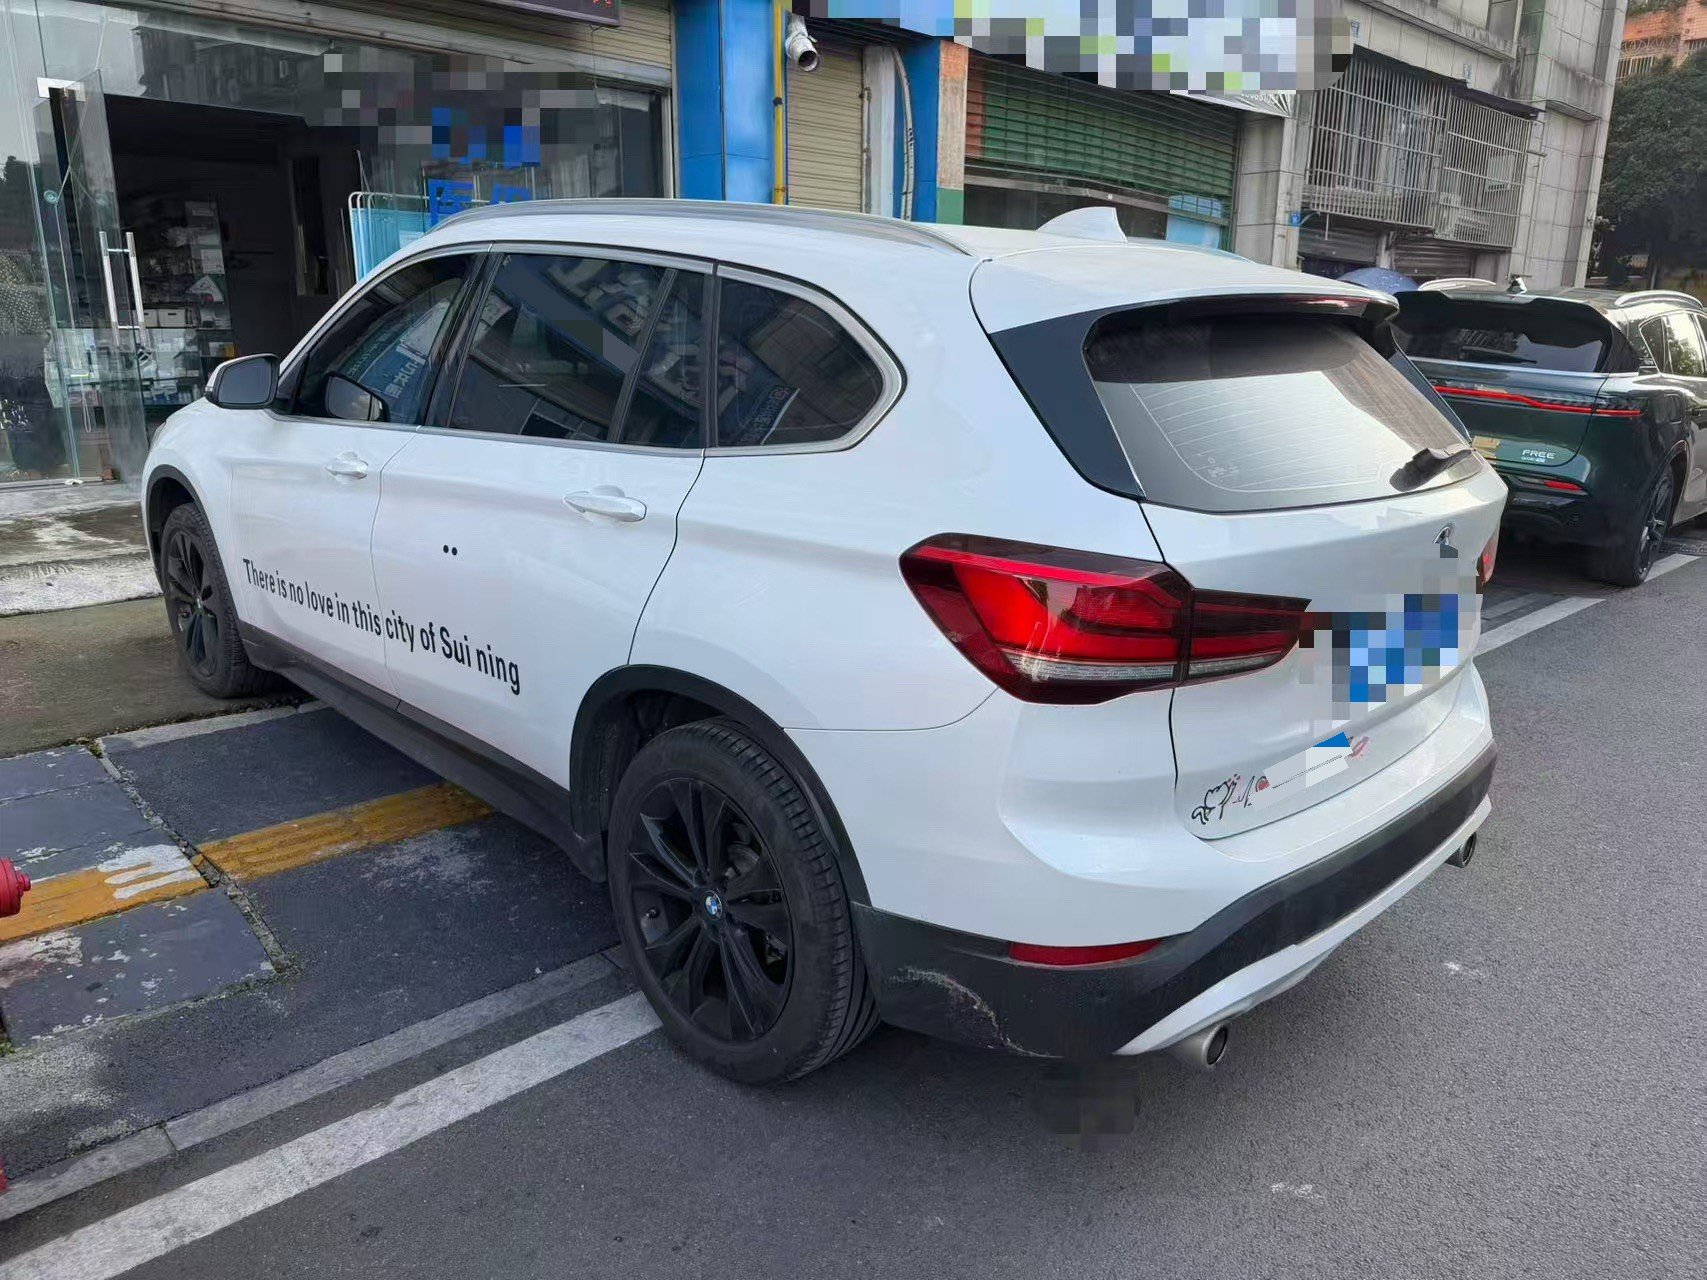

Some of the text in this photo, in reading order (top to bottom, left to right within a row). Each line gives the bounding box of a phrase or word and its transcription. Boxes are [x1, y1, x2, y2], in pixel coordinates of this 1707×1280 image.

[1522, 449, 1555, 459] FREE
[242, 558, 520, 695] There is no love in this city of Sui ning
